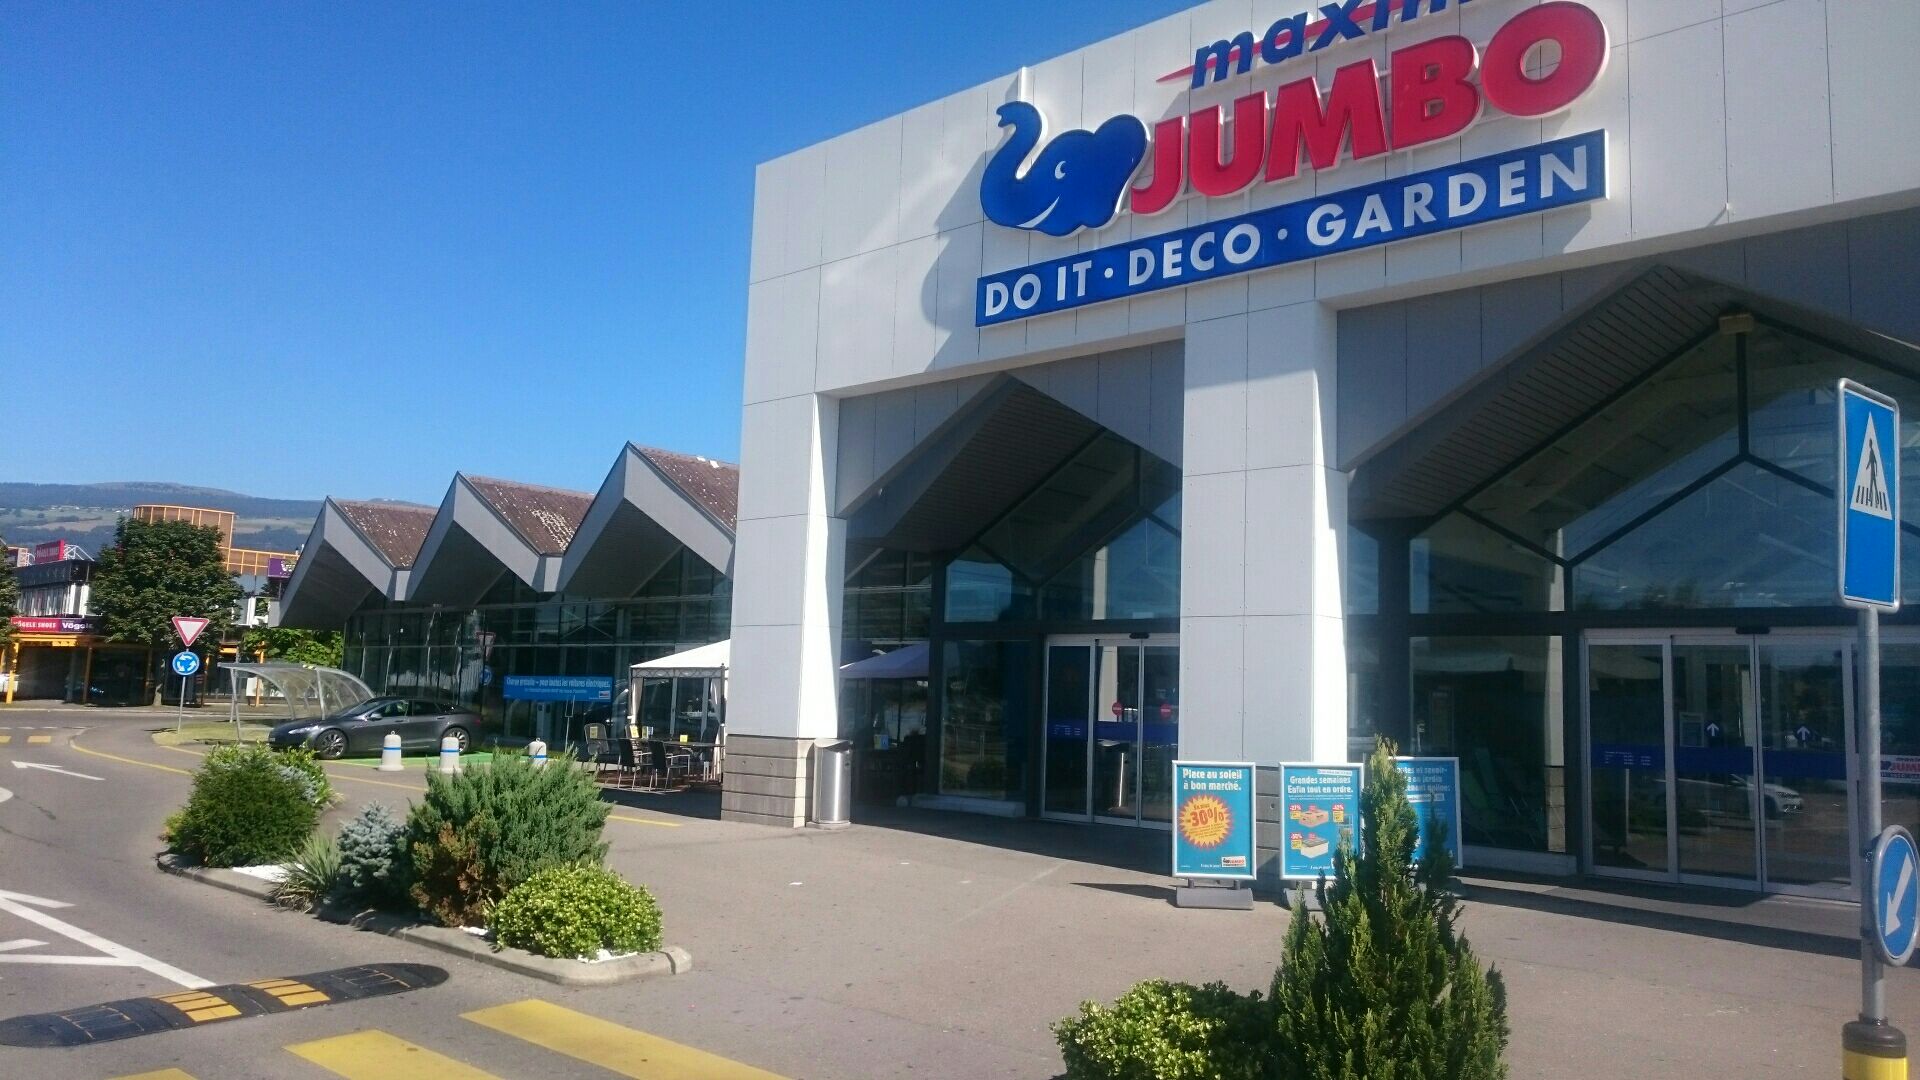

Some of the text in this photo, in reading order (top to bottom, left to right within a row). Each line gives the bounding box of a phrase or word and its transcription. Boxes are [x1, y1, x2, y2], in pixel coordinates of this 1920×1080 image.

[1191, 0, 1473, 88] maxi
[1131, 1, 1609, 214] JUMBO
[985, 145, 1588, 317] DO IT DECO GARDEN
[1183, 768, 1243, 779] Place au soleil
[1184, 780, 1242, 791] à bon marché.
[1290, 776, 1351, 784] Grandes semaines
[1287, 785, 1306, 794] Enfin
[1307, 785, 1321, 794] tout
[1332, 785, 1353, 793] ordre.
